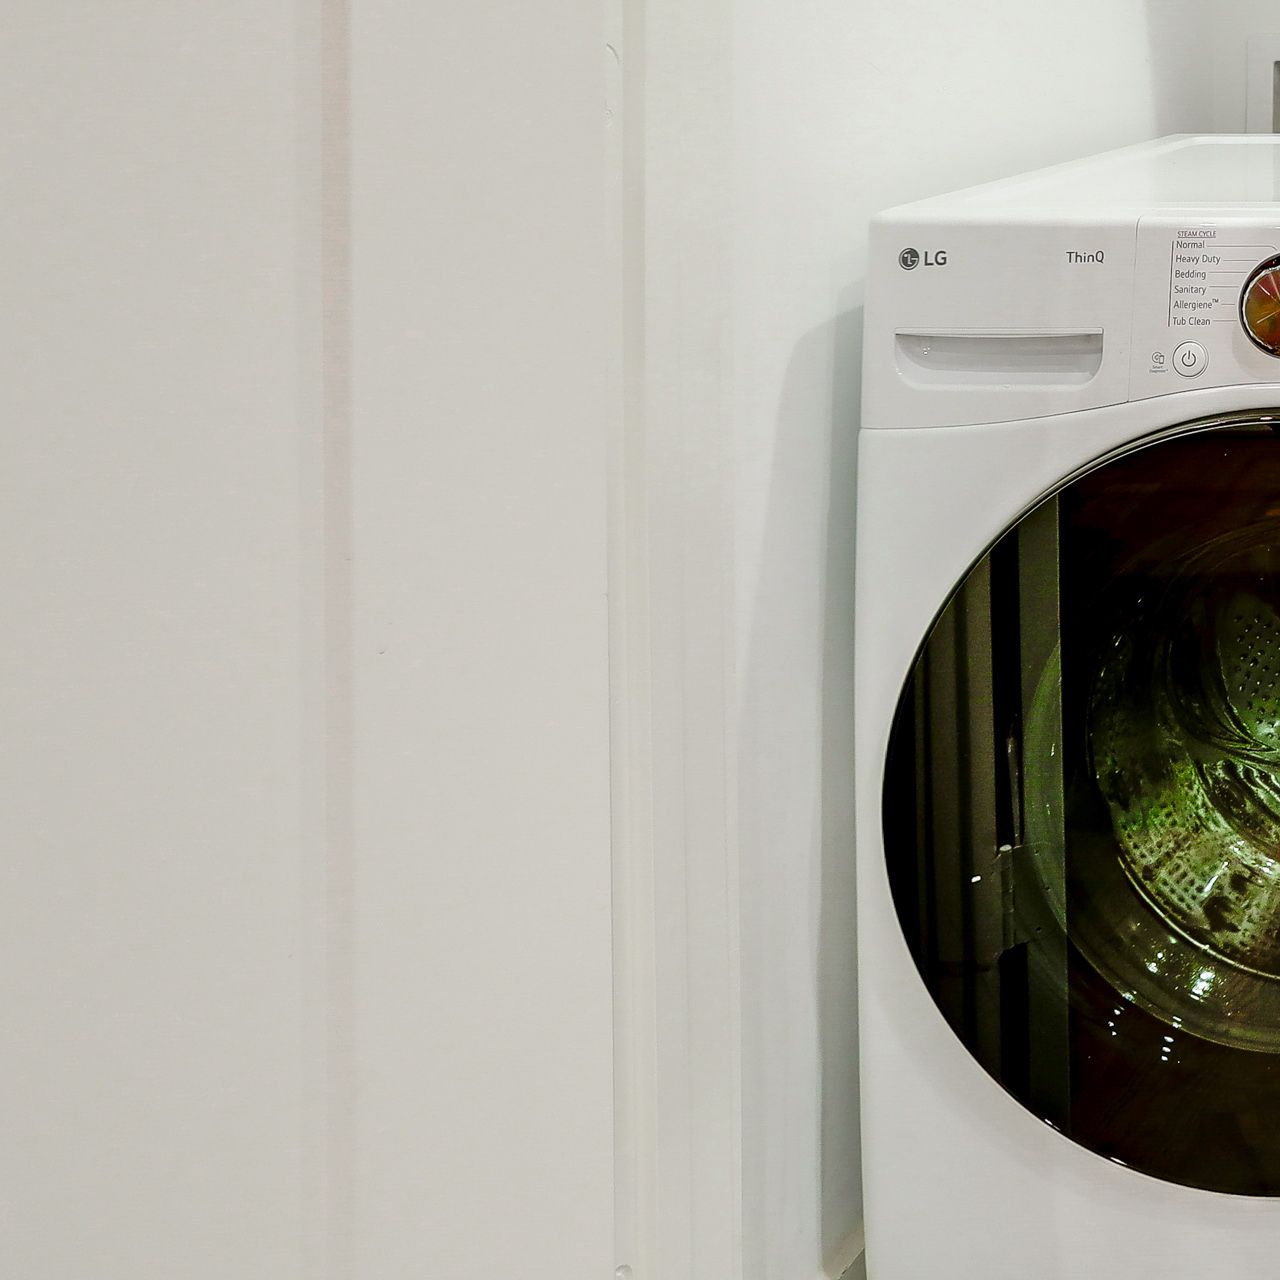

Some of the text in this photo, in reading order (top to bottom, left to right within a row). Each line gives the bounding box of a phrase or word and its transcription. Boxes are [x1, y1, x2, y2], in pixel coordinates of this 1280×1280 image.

[1176, 240, 1205, 249] Normal
[924, 251, 947, 266] LG
[1066, 250, 1105, 264] ThinQ
[1175, 254, 1221, 265] Heavy Duty
[1175, 270, 1207, 280] Bedding
[1174, 285, 1207, 296] Sanitary
[1173, 317, 1211, 326] Tub Clean
